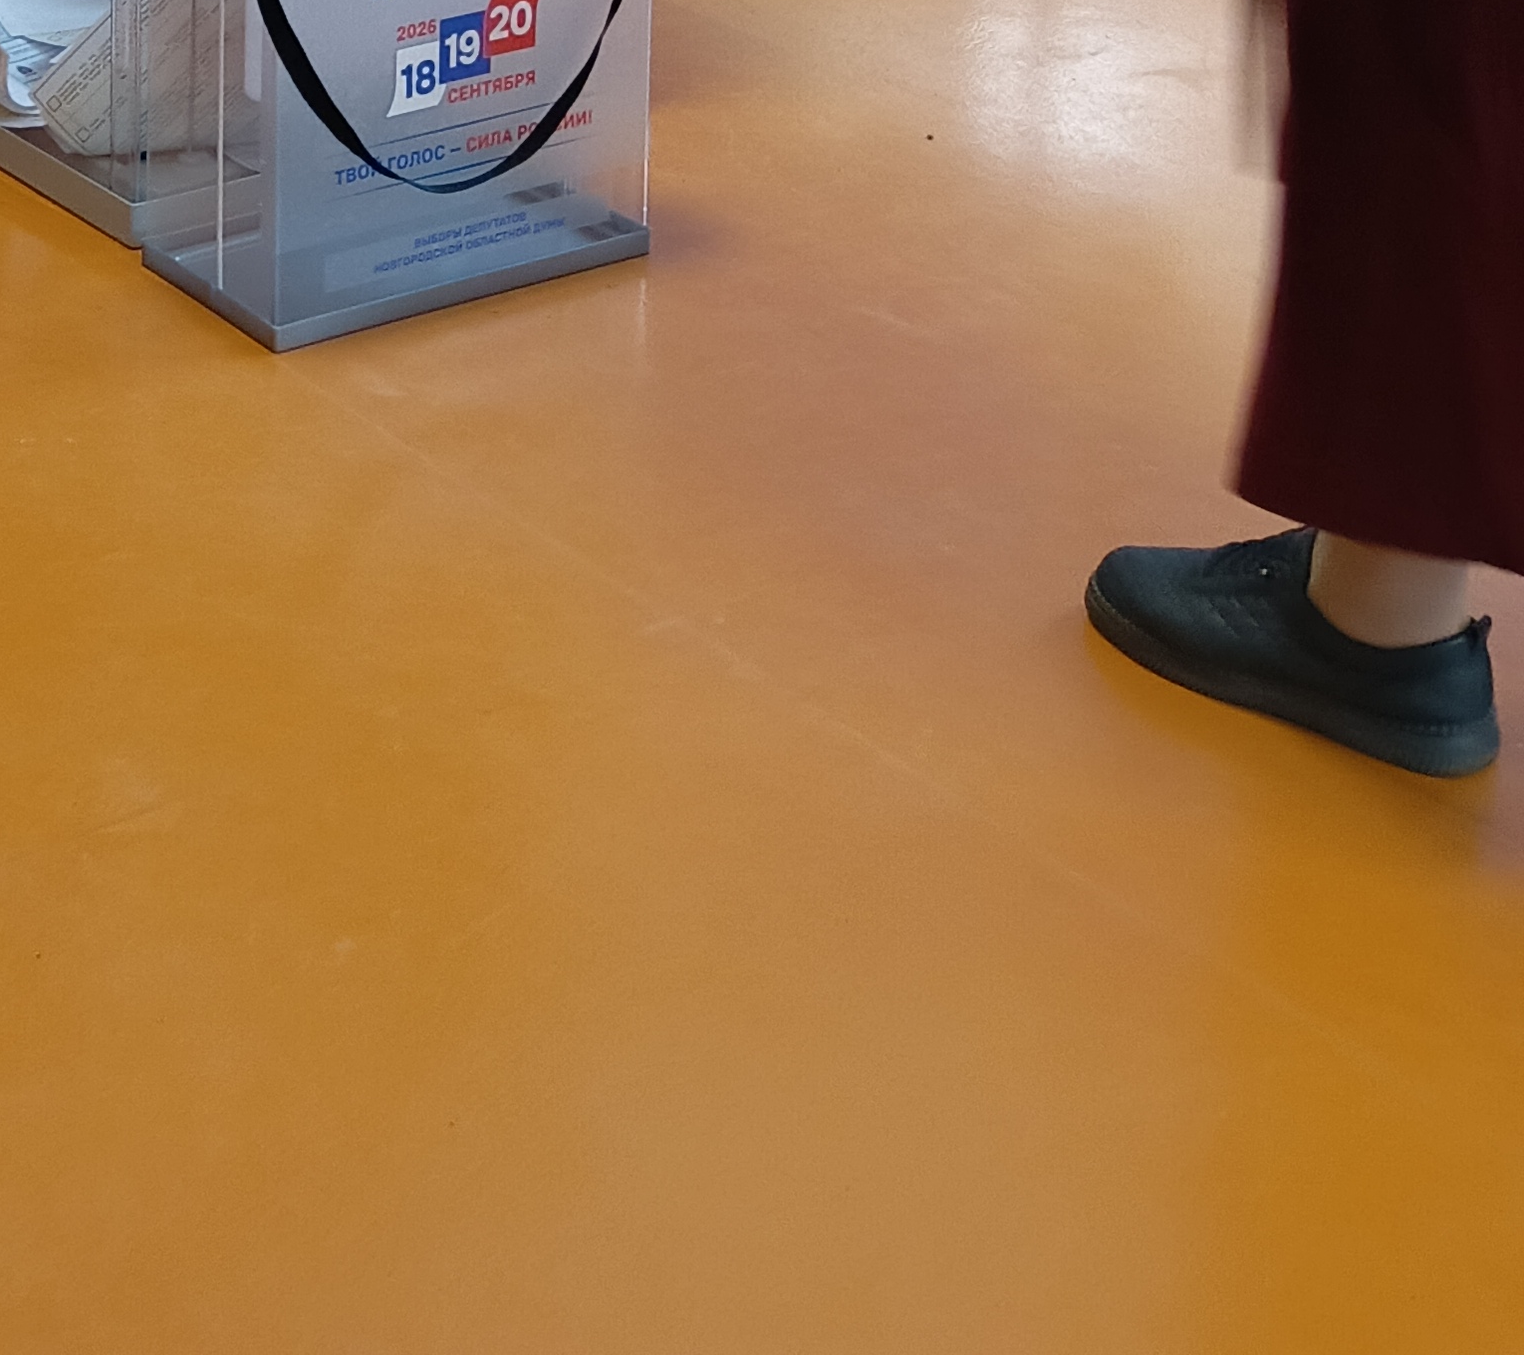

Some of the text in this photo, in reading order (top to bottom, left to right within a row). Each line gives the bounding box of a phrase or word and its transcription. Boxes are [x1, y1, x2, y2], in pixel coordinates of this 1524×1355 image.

[396, 18, 437, 43] 2026
[400, 0, 533, 99] 18 19 20
[447, 70, 536, 104] СЕНТЯБРЯ
[387, 145, 445, 171] ГОЛОС
[465, 128, 512, 154] СИЛА
[517, 109, 593, 141] РОИИ!
[413, 211, 527, 249] ВЫБОРЫ ДЕПУТАТОВ
